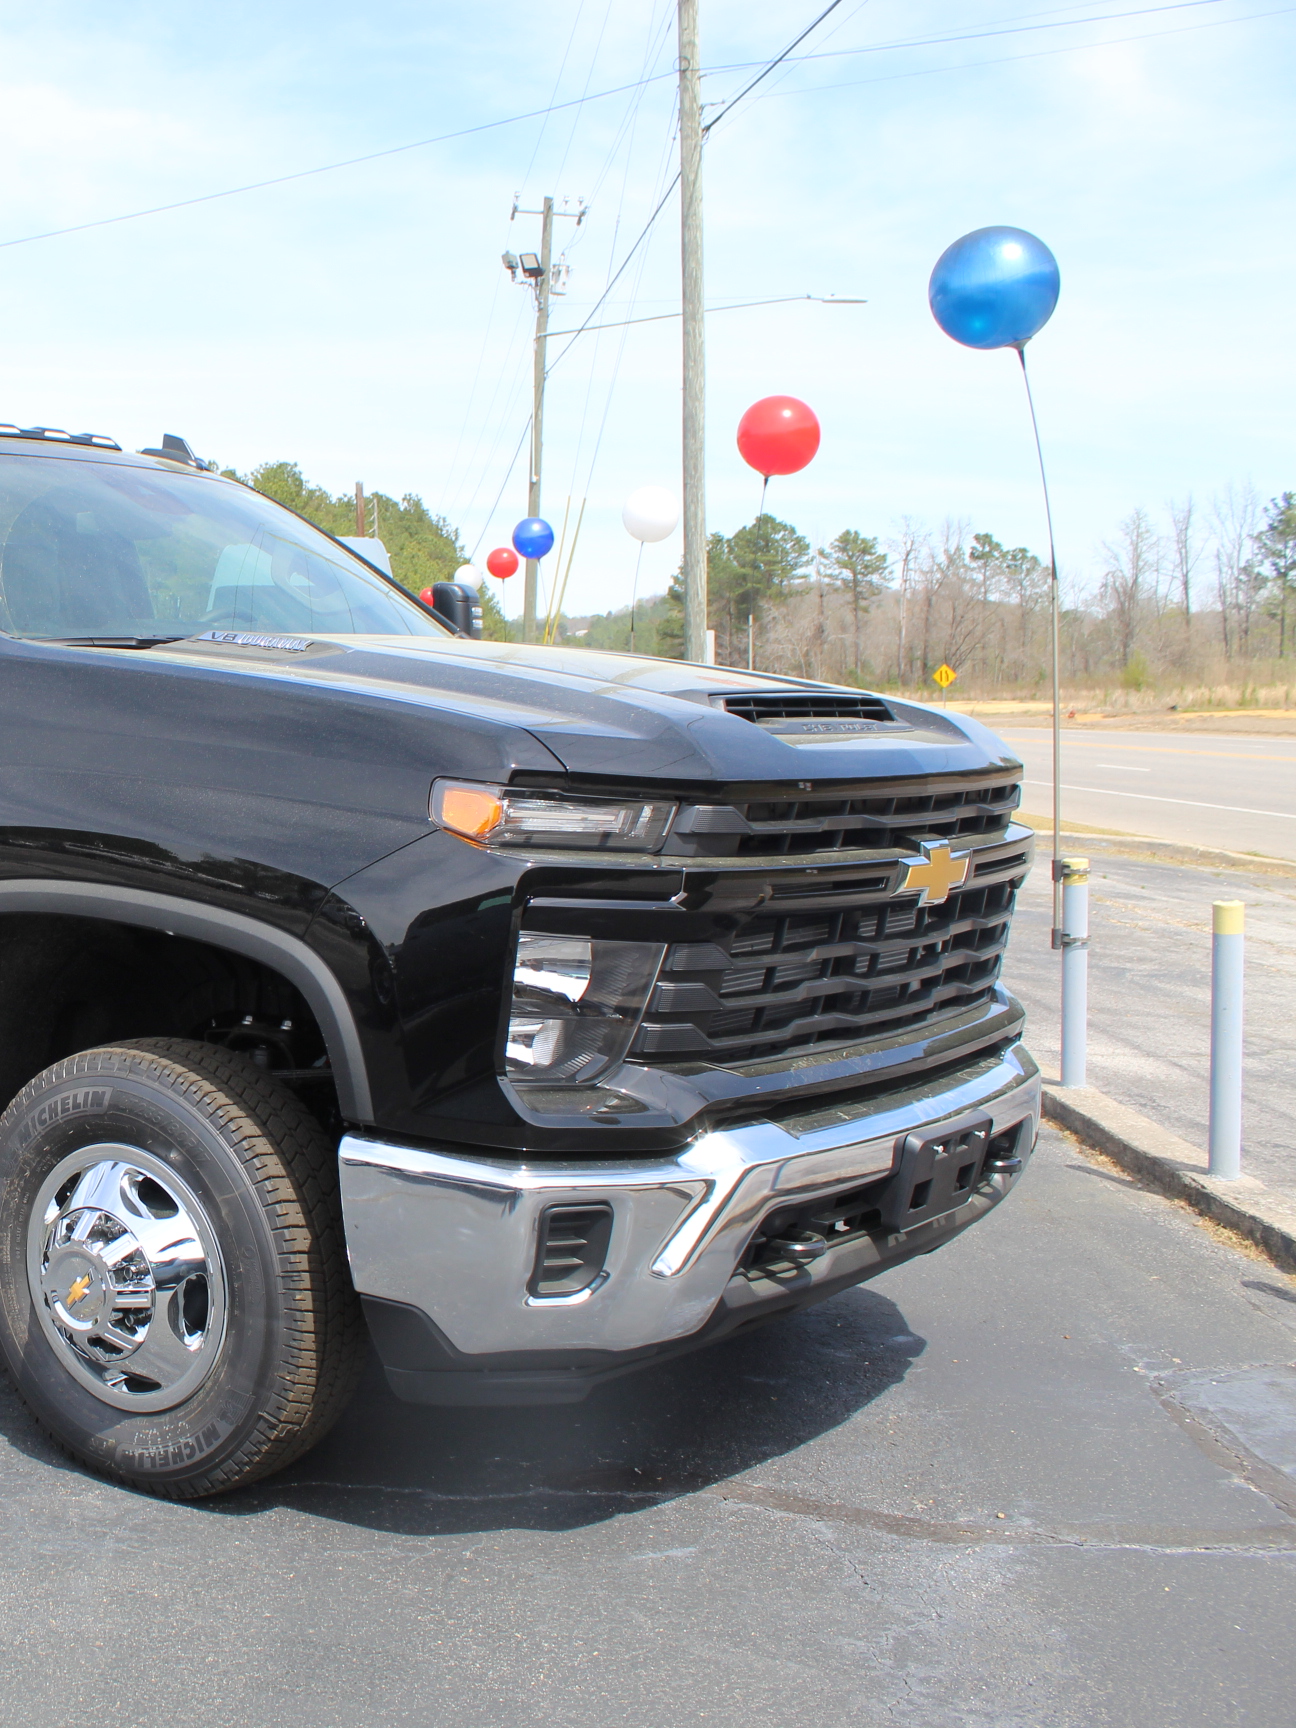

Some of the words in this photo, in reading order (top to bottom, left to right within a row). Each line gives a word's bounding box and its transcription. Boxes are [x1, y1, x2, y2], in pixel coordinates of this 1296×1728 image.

[211, 631, 239, 641] V8
[18, 1091, 107, 1144] MICHELIN
[120, 1421, 222, 1469] MICHELIN
